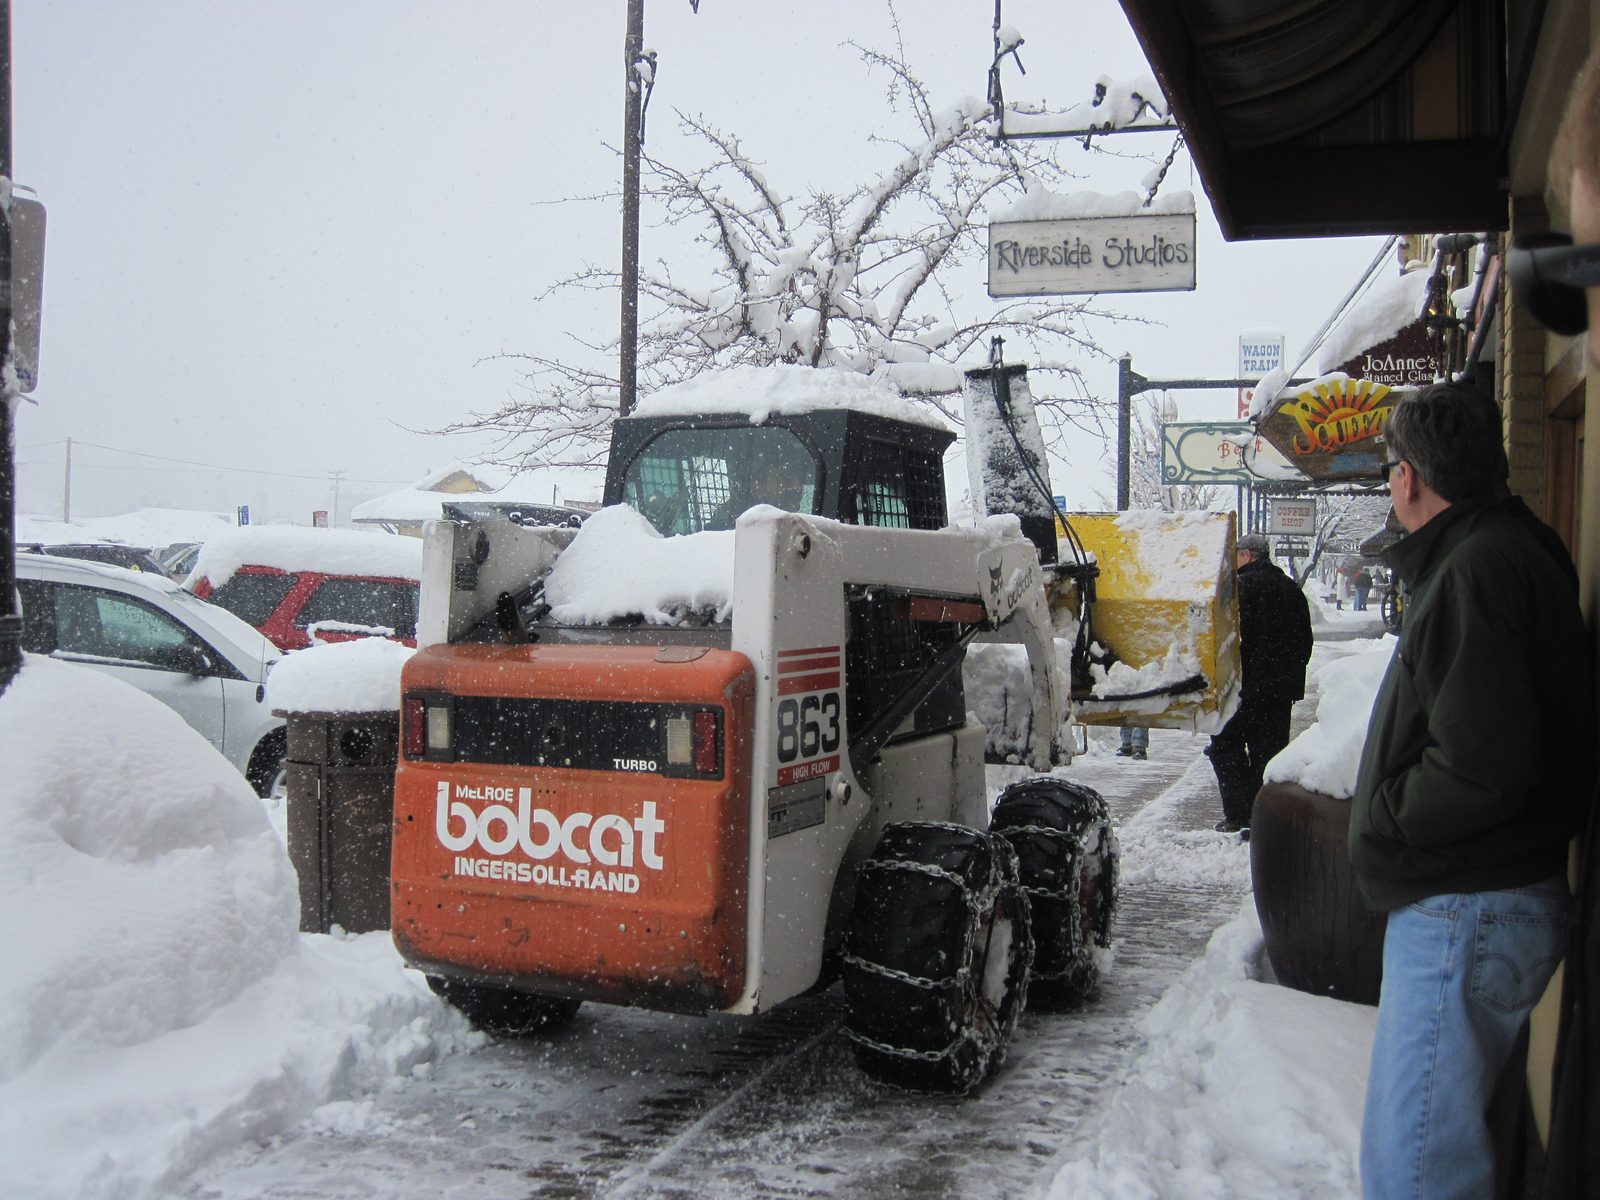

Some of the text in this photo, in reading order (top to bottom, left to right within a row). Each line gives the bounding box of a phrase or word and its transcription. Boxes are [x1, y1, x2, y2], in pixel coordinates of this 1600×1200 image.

[993, 234, 1188, 274] Riverside Studios
[1242, 344, 1280, 356] WAGON
[1243, 360, 1279, 371] TRAIN
[1408, 371, 1434, 382] Glas
[1277, 507, 1310, 517] COFFEE
[1281, 518, 1305, 527] SHOP
[777, 692, 840, 763] 863
[613, 759, 657, 771] TURBO
[792, 760, 831, 780] HIGH FLOW
[456, 785, 514, 803] MELROE
[436, 781, 665, 870] bobcat
[454, 857, 640, 894] INGERSOLL-RAND
